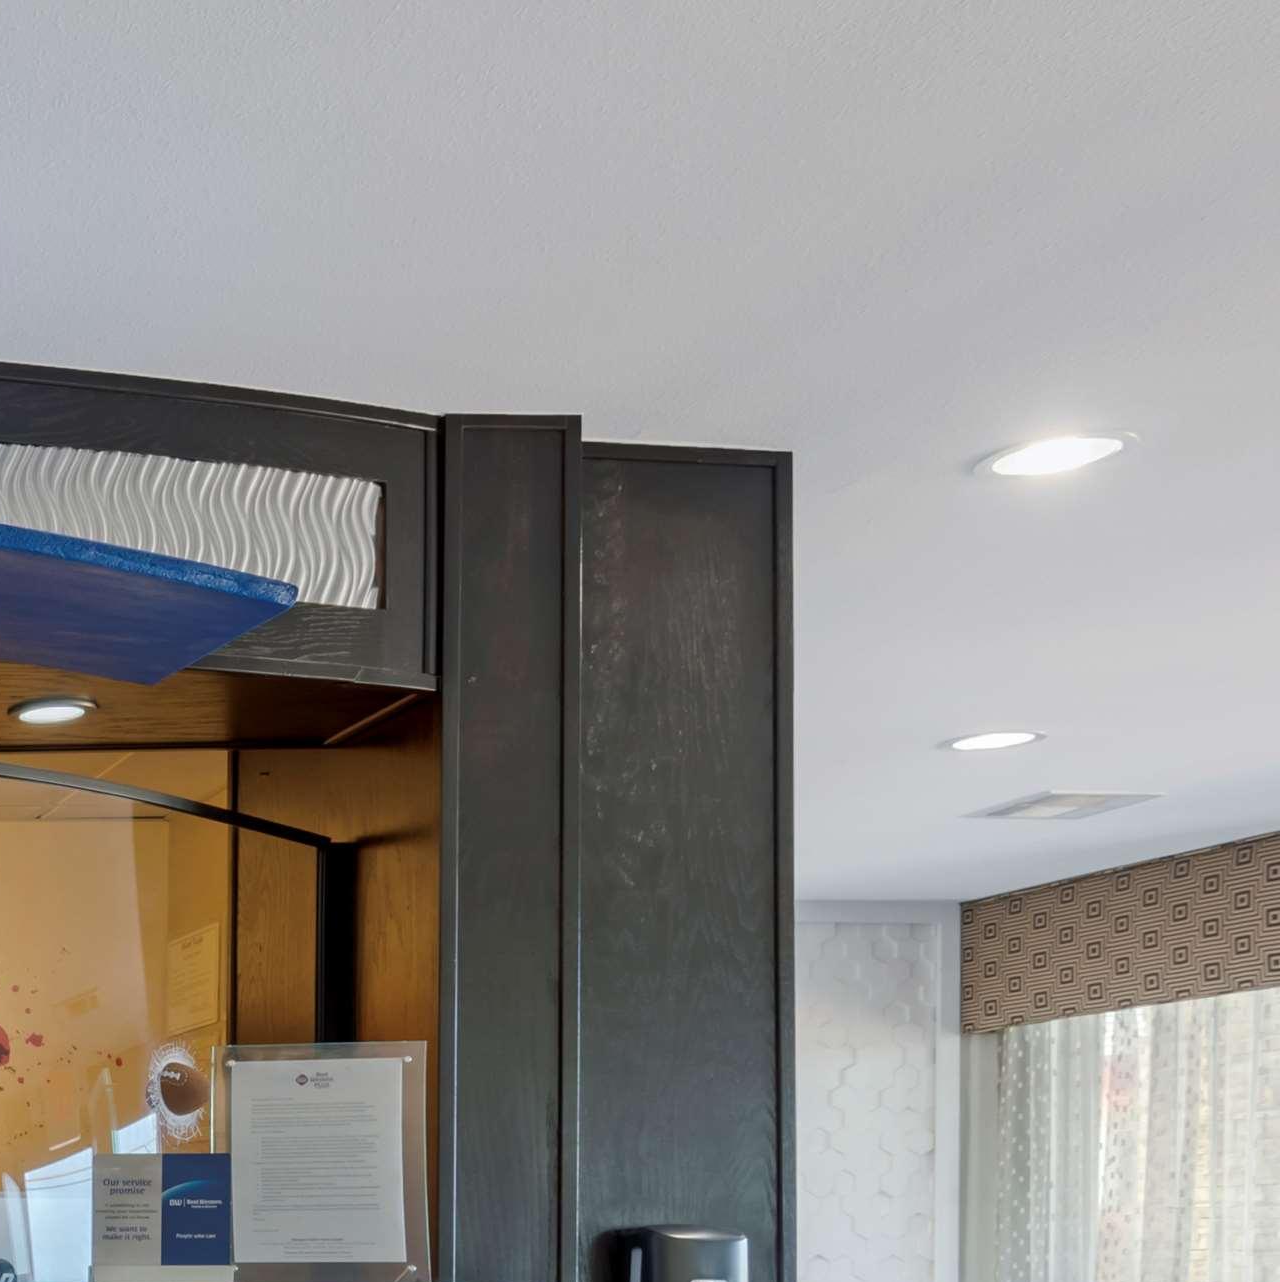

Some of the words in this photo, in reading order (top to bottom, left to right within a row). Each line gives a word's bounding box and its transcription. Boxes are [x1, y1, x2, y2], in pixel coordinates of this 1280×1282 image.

[102, 1178, 120, 1186] Our
[122, 1178, 152, 1186] service
[109, 1187, 146, 1195] promise
